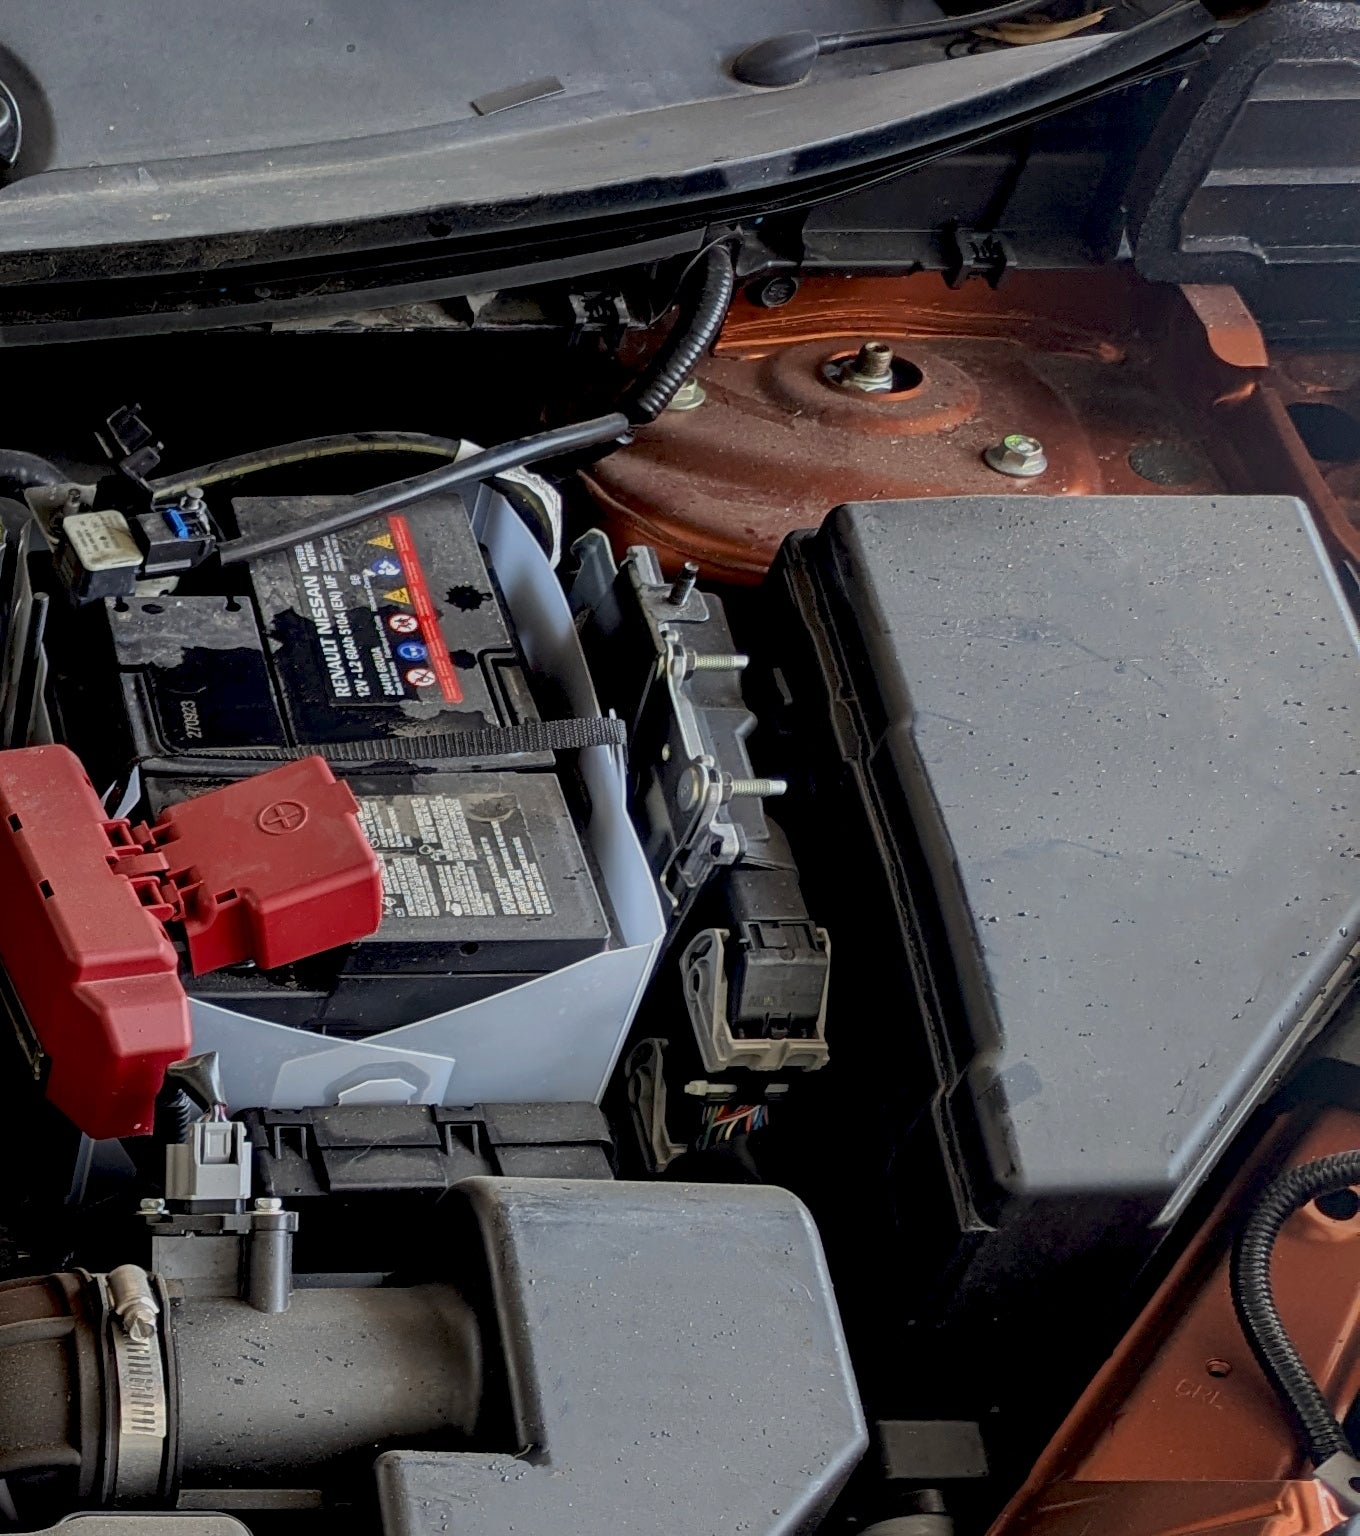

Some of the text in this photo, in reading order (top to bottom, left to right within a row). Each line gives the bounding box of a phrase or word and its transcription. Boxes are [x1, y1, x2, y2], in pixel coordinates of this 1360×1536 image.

[302, 575, 334, 635] NISSAN
[320, 637, 352, 698] RENAULT
[355, 680, 371, 698] 12V
[179, 700, 202, 737] 270923
